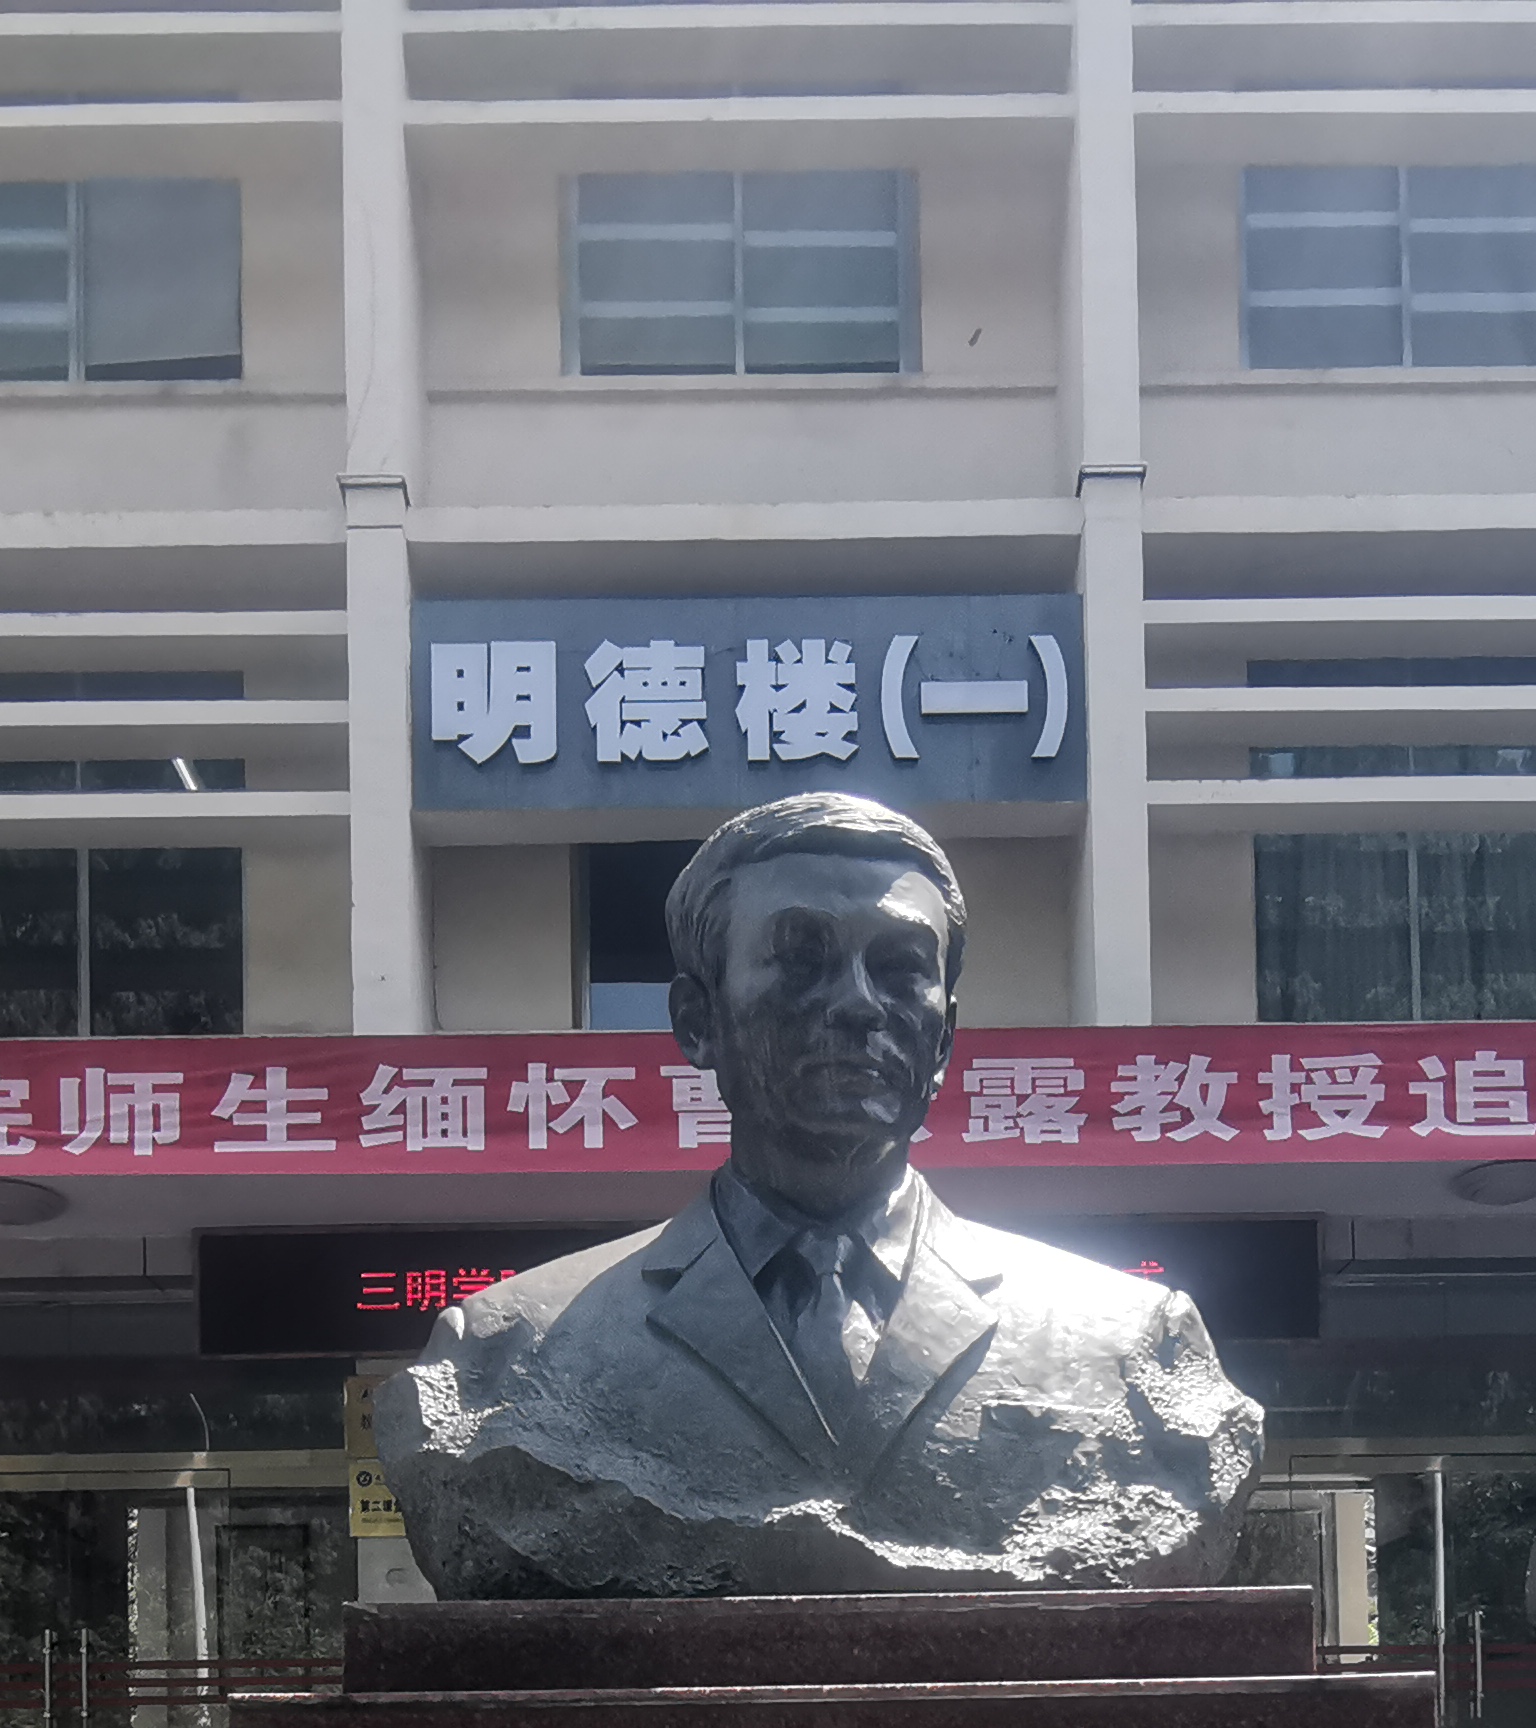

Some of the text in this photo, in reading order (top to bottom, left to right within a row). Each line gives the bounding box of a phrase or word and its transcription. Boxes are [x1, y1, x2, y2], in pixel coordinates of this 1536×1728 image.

[430, 634, 1069, 764] 明德楼(一)
[356, 1268, 517, 1311] 三明学
